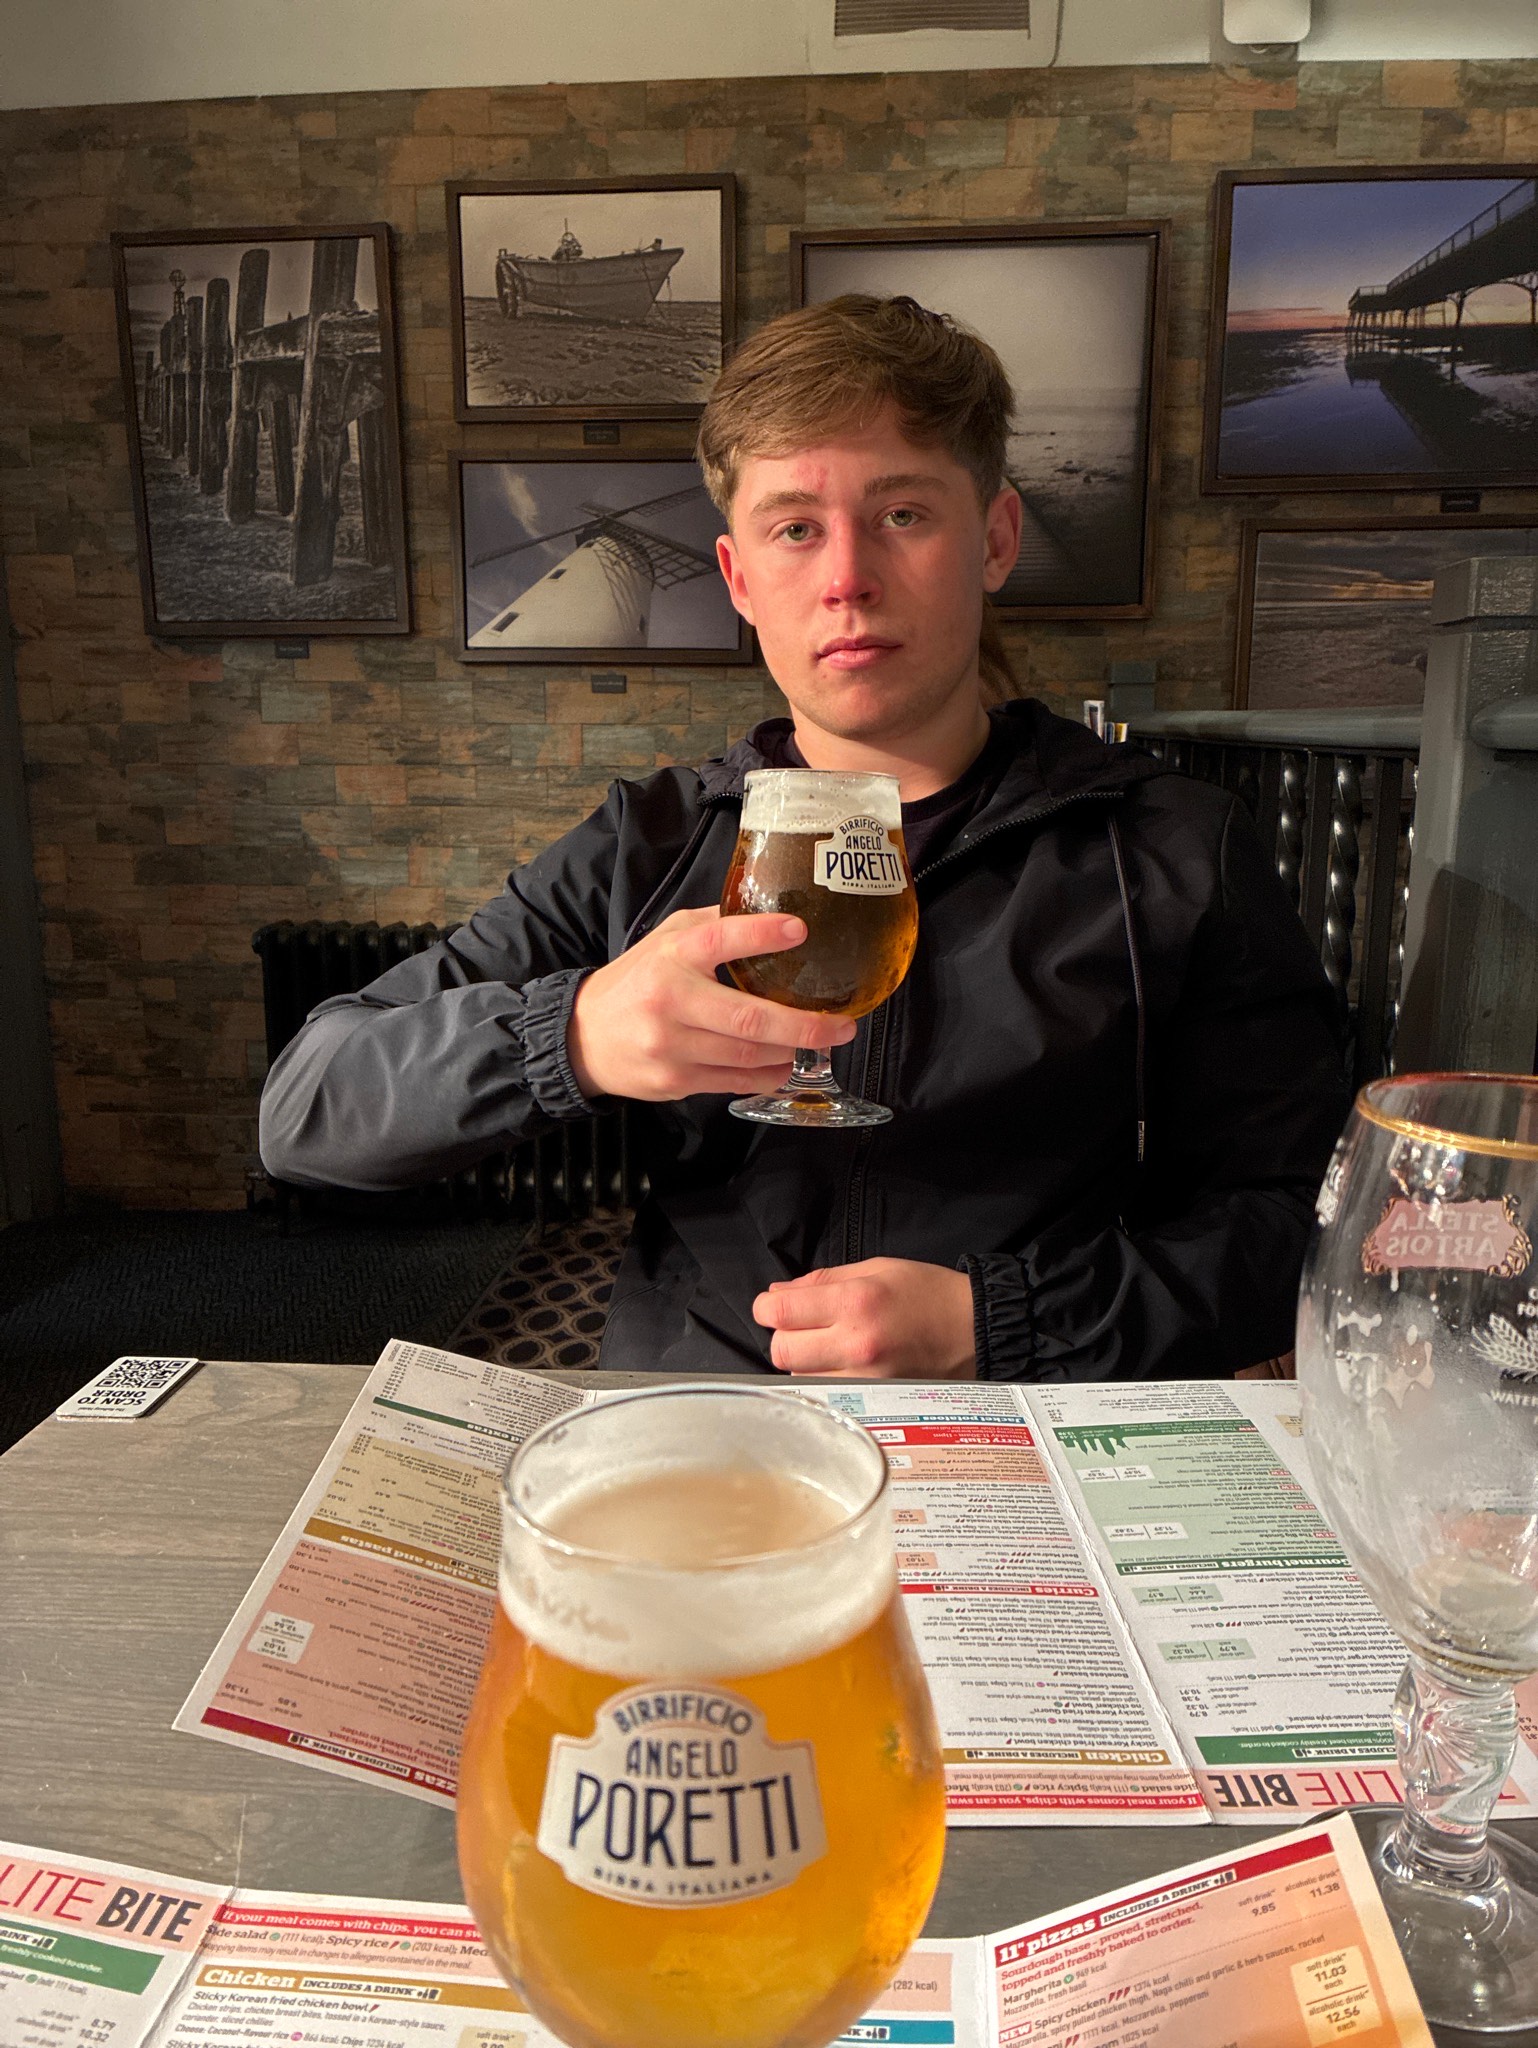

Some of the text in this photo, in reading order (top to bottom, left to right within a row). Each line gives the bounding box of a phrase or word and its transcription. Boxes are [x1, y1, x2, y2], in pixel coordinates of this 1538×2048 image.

[839, 818, 884, 837] BIRRIFICIO
[846, 835, 882, 850] ANGELO
[826, 852, 901, 881] PORETTI
[466, 1423, 509, 1439] extras
[992, 1437, 1030, 1445] Curry
[340, 1535, 475, 1580] salads and pastas
[1221, 1559, 1283, 1568] burgers
[1035, 1588, 1094, 1596] Curries
[264, 1641, 286, 1652] 11.03
[613, 1694, 752, 1735] BIRRIFICIO
[356, 1754, 408, 1776] INCLUDES
[626, 1736, 738, 1778] ANGELO
[1085, 1752, 1164, 1763] Chicken
[1207, 1770, 1404, 1808] LITE BITE
[1000, 1796, 1022, 1805] you
[1023, 1796, 1057, 1806] chips,
[1059, 1798, 1085, 1806] with
[1127, 1798, 1156, 1806] meal
[1159, 1796, 1186, 1806] your
[568, 1765, 800, 1868] PORETTI
[593, 1866, 773, 1896] BIRRA ITALIANA
[1238, 1897, 1252, 1908] soft
[1285, 1876, 1318, 1892] alcoholic
[1252, 1883, 1340, 1917] 9.85 11.38
[96, 1886, 203, 1942] BITE
[223, 1910, 234, 1920] If
[234, 1912, 264, 1924] your
[266, 1914, 297, 1925] meal
[299, 1917, 340, 1928] comes
[343, 1918, 371, 1930] with
[373, 1921, 410, 1933] chips,
[413, 1925, 438, 1936] you
[440, 1927, 463, 1937] can
[998, 1880, 1210, 1963] 11" pizzas INCLUDES A DRINK
[206, 1925, 231, 1938] Side
[233, 1929, 267, 1940] salad
[326, 1936, 362, 1948] Spicy
[363, 1938, 389, 1948] rice
[412, 1942, 432, 1952] (203
[1001, 1951, 1062, 1981] Sourdough
[1064, 1942, 1092, 1958] base
[1100, 1922, 1144, 1948] proved,
[1145, 1902, 1204, 1928] stretched,
[33, 1951, 66, 1965] cooked
[1002, 1916, 1195, 1992] topped and freshly baked to order.
[1306, 1961, 1322, 1972] soft
[1315, 1966, 1347, 1982] 11.03
[204, 1969, 414, 1996] Chicken INCLUDES A DRINK
[893, 1980, 938, 1992] (282 kcal)
[1003, 1962, 1107, 2006] Margherita 949 kcal
[1050, 2021, 1070, 2039] spicy
[1072, 2010, 1096, 2029] pulled
[1097, 2000, 1128, 2020] chicken
[1129, 1992, 1151, 2010] thigh,
[1152, 1984, 1172, 2001] Naga
[1174, 1976, 1194, 1992] chilli
[1196, 1972, 1210, 1984] and
[1212, 1964, 1236, 1981] garlic
[1244, 1951, 1264, 1967] herb
[1266, 1944, 1295, 1960] sauces,
[1298, 1934, 1325, 1951] rocket
[1324, 1978, 1344, 1990] each
[193, 1990, 368, 2012] Sticky Korean fried chicken bowl
[1000, 2024, 1031, 2042] NEW
[1035, 2012, 1064, 2032] Spicy
[1065, 1997, 1107, 2018] chicken
[1152, 1974, 1170, 1987] kcal
[1003, 1980, 1088, 2017] Mozzarella, fresh basil
[1169, 1991, 1209, 2012] pepperoni
[1309, 2000, 1344, 2016] alcoholic
[1326, 2006, 1360, 2024] 12.56
[1337, 2020, 1356, 2032] each
